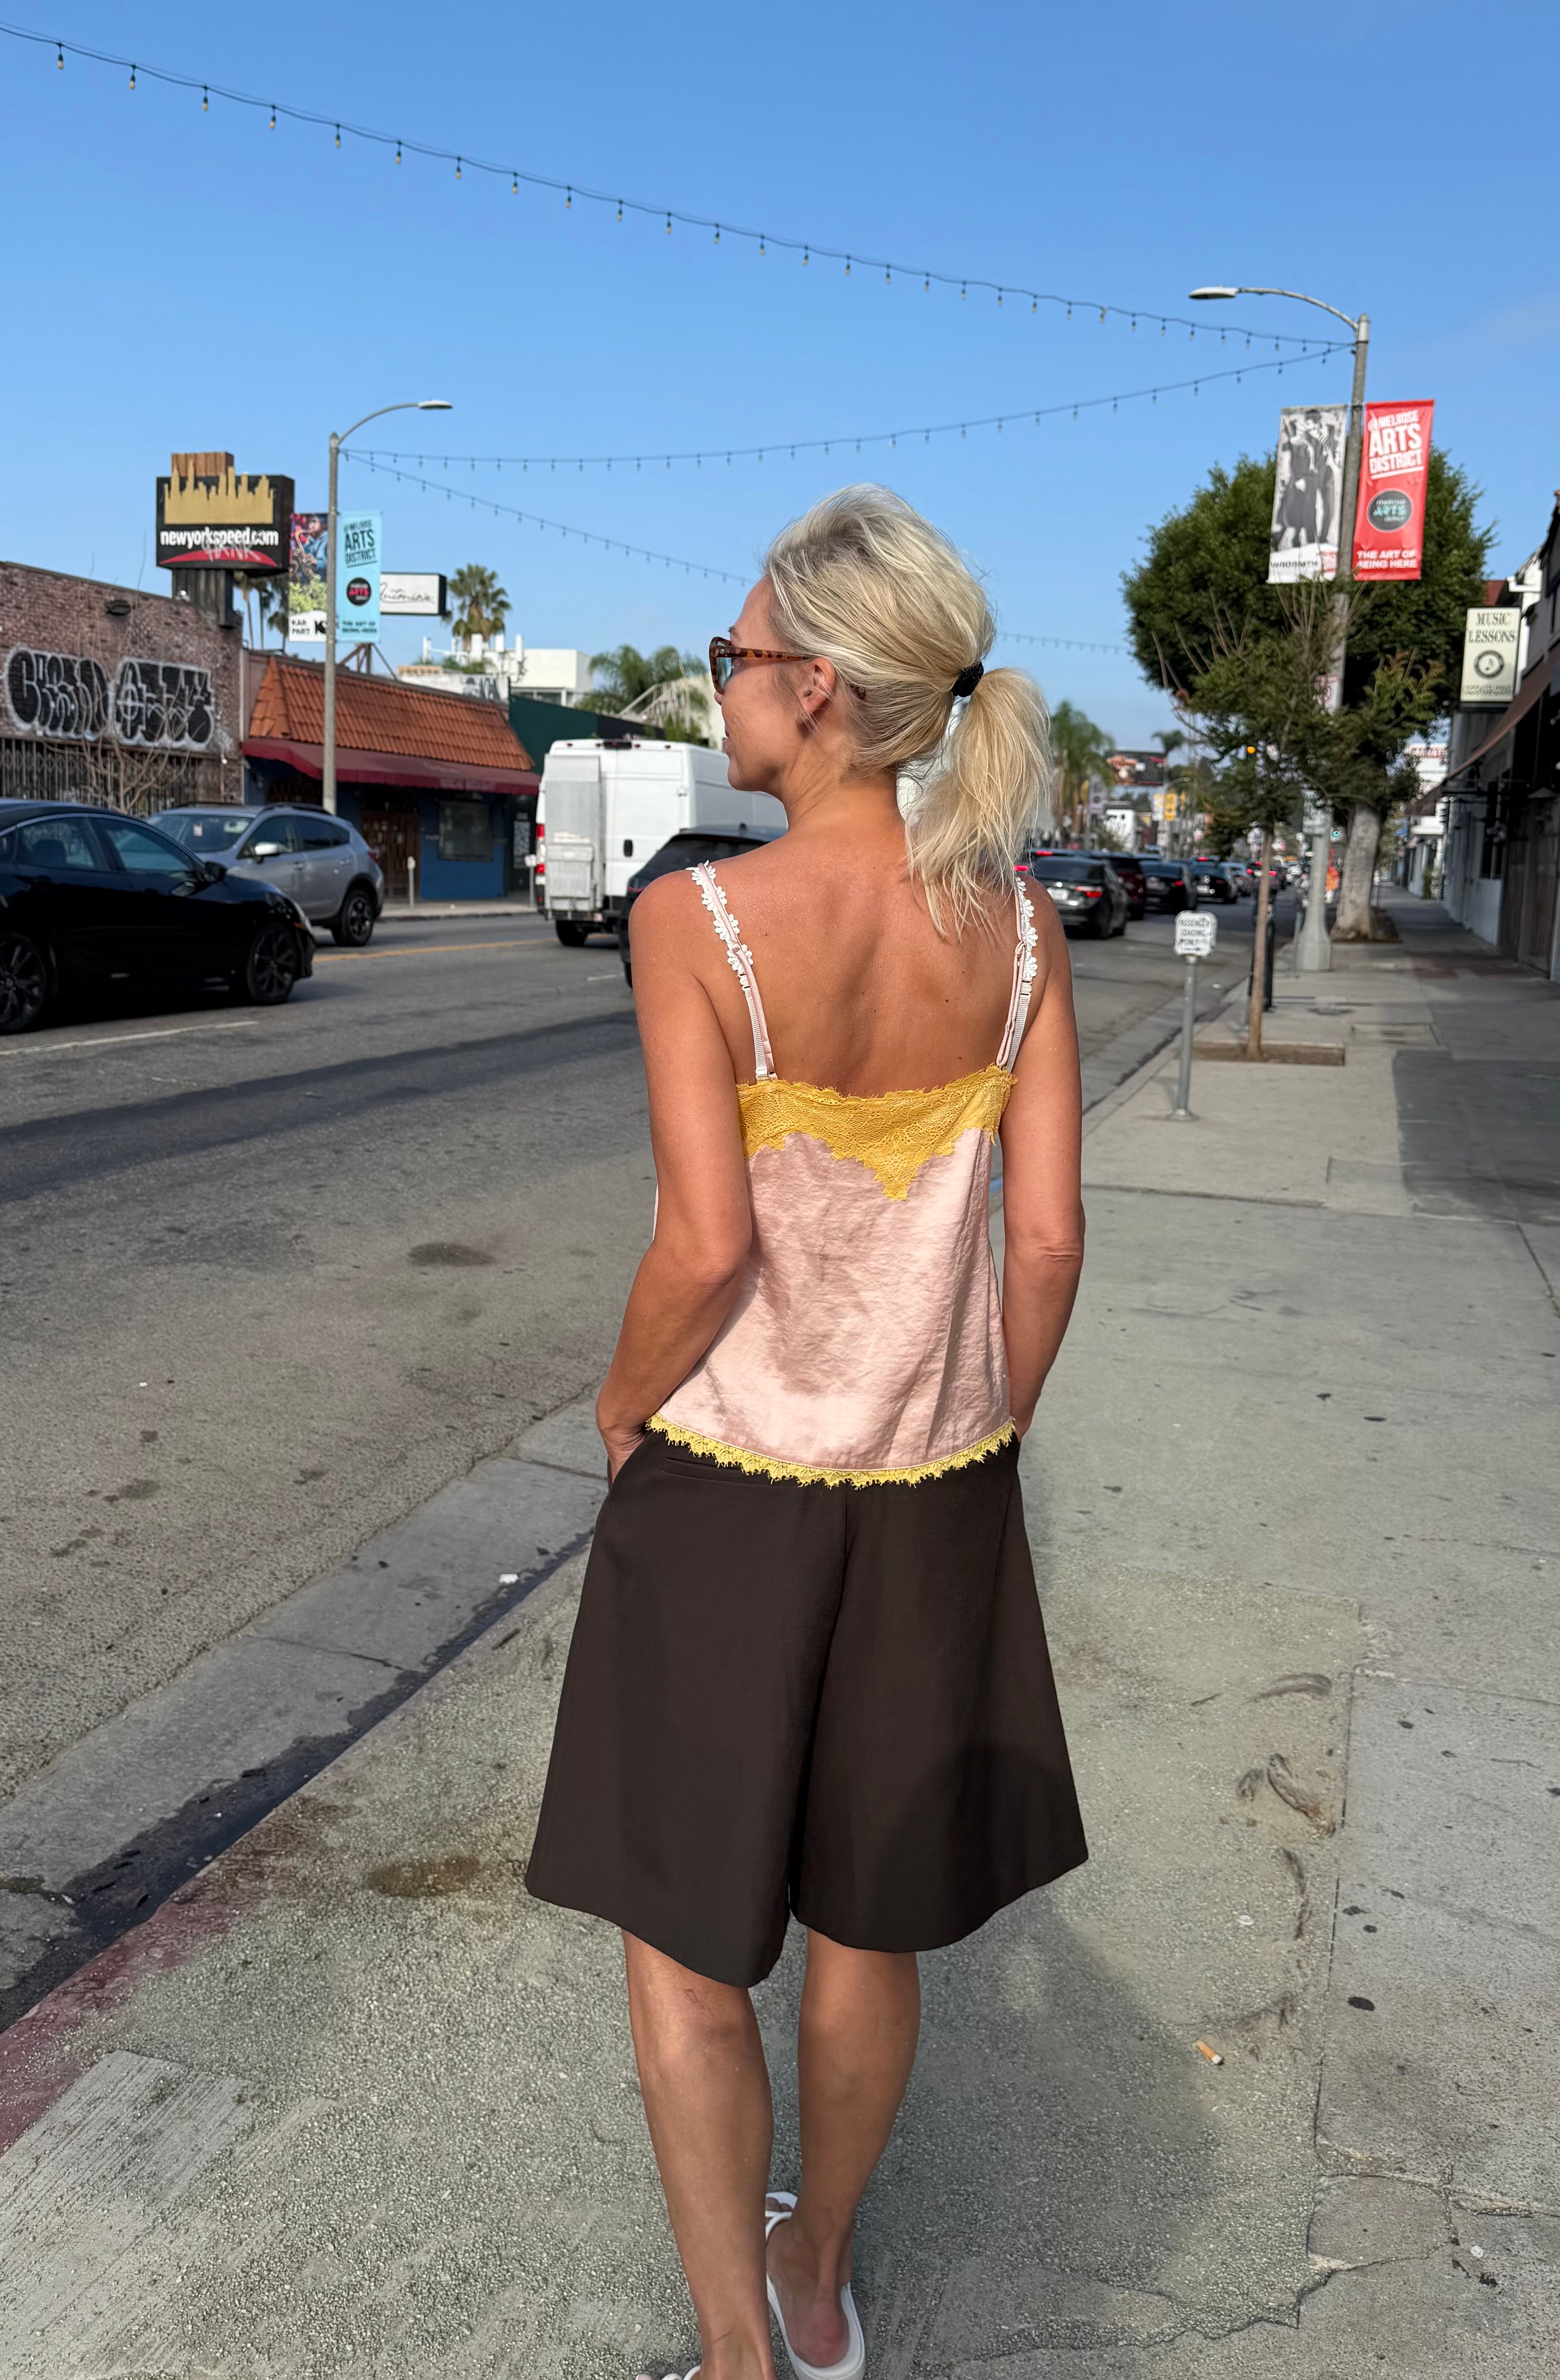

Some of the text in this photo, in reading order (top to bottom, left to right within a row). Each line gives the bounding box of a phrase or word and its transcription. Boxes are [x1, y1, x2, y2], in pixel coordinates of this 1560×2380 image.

[1369, 423, 1423, 458] ARTS
[1369, 449, 1423, 475] DISTRICT
[160, 526, 279, 549] newyorkspeed.com
[344, 529, 375, 552] ARTS
[1356, 548, 1416, 559] THE ART OF
[1389, 558, 1418, 568] HERE
[1476, 612, 1511, 626] MUSIC
[1467, 629, 1516, 644] LESSONS
